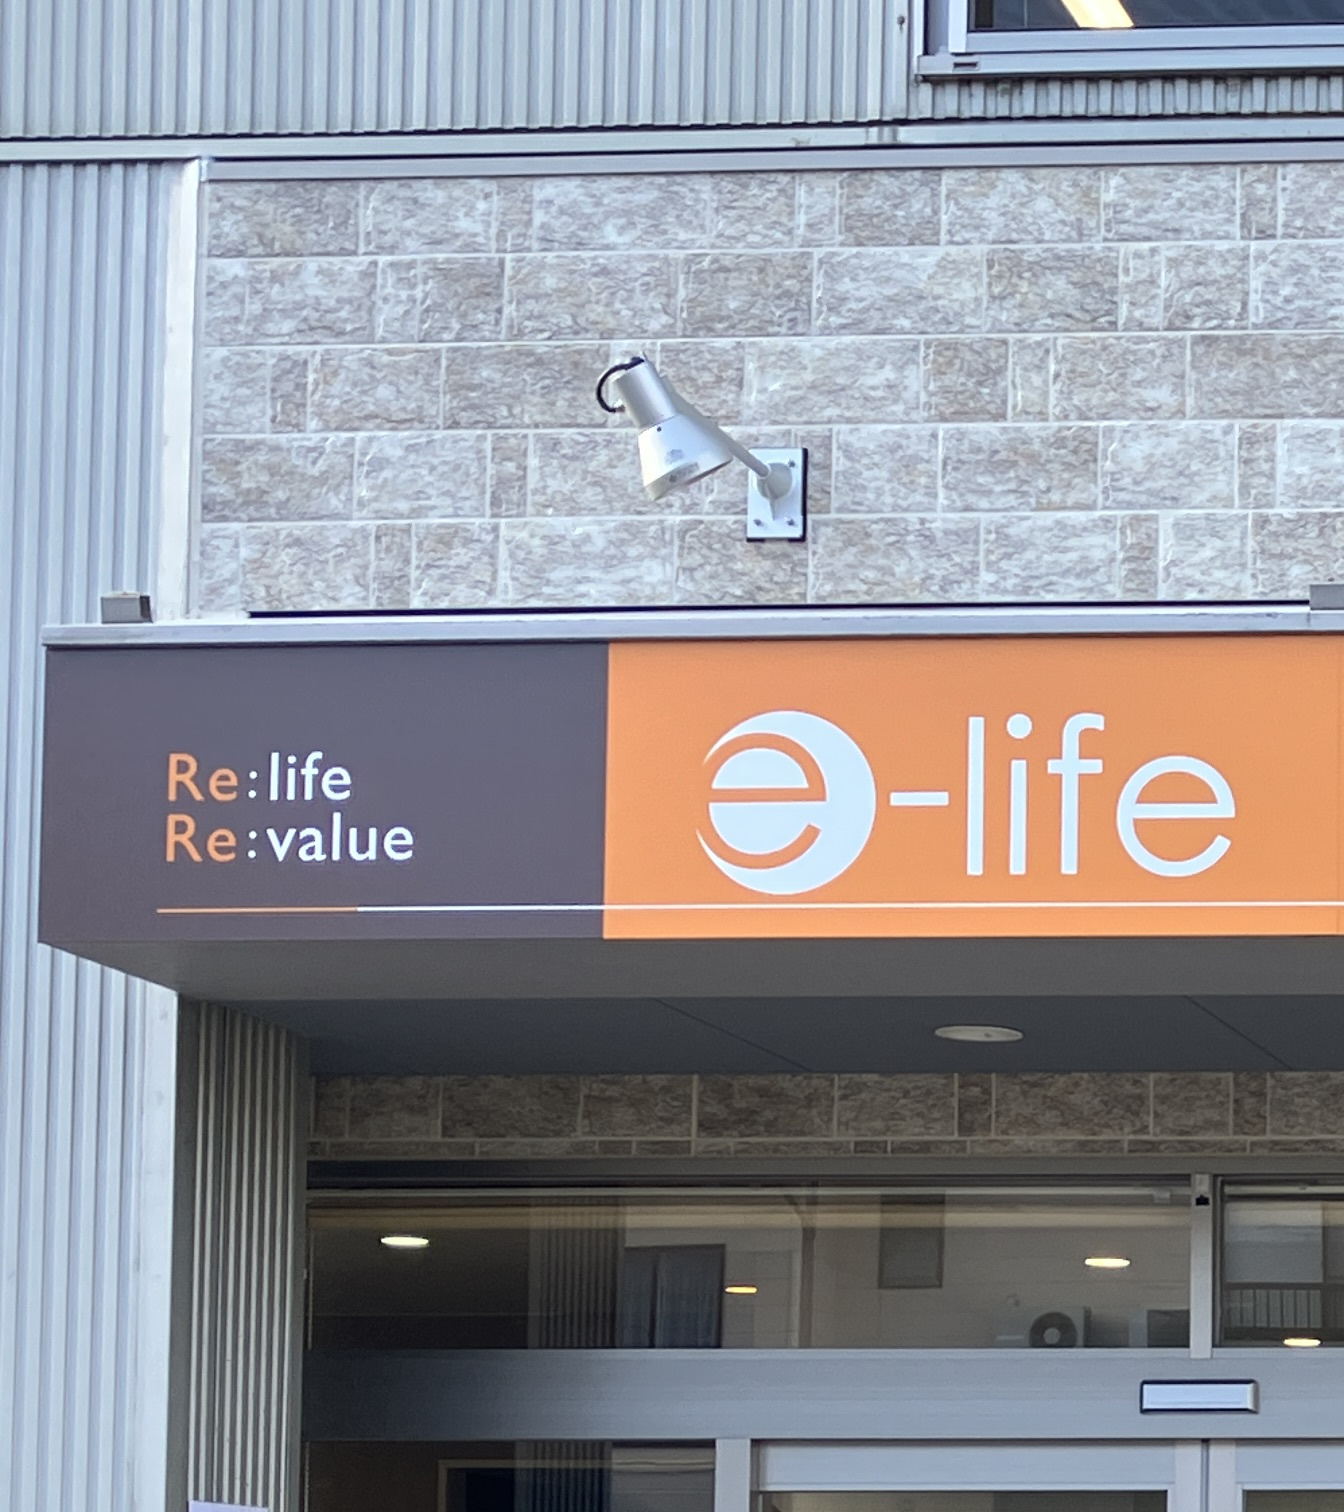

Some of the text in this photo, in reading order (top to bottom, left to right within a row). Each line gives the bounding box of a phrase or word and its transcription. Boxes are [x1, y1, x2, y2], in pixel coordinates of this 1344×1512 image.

[166, 750, 353, 803] Re:life
[697, 709, 1236, 896] e-life
[165, 811, 415, 863] Re:value
